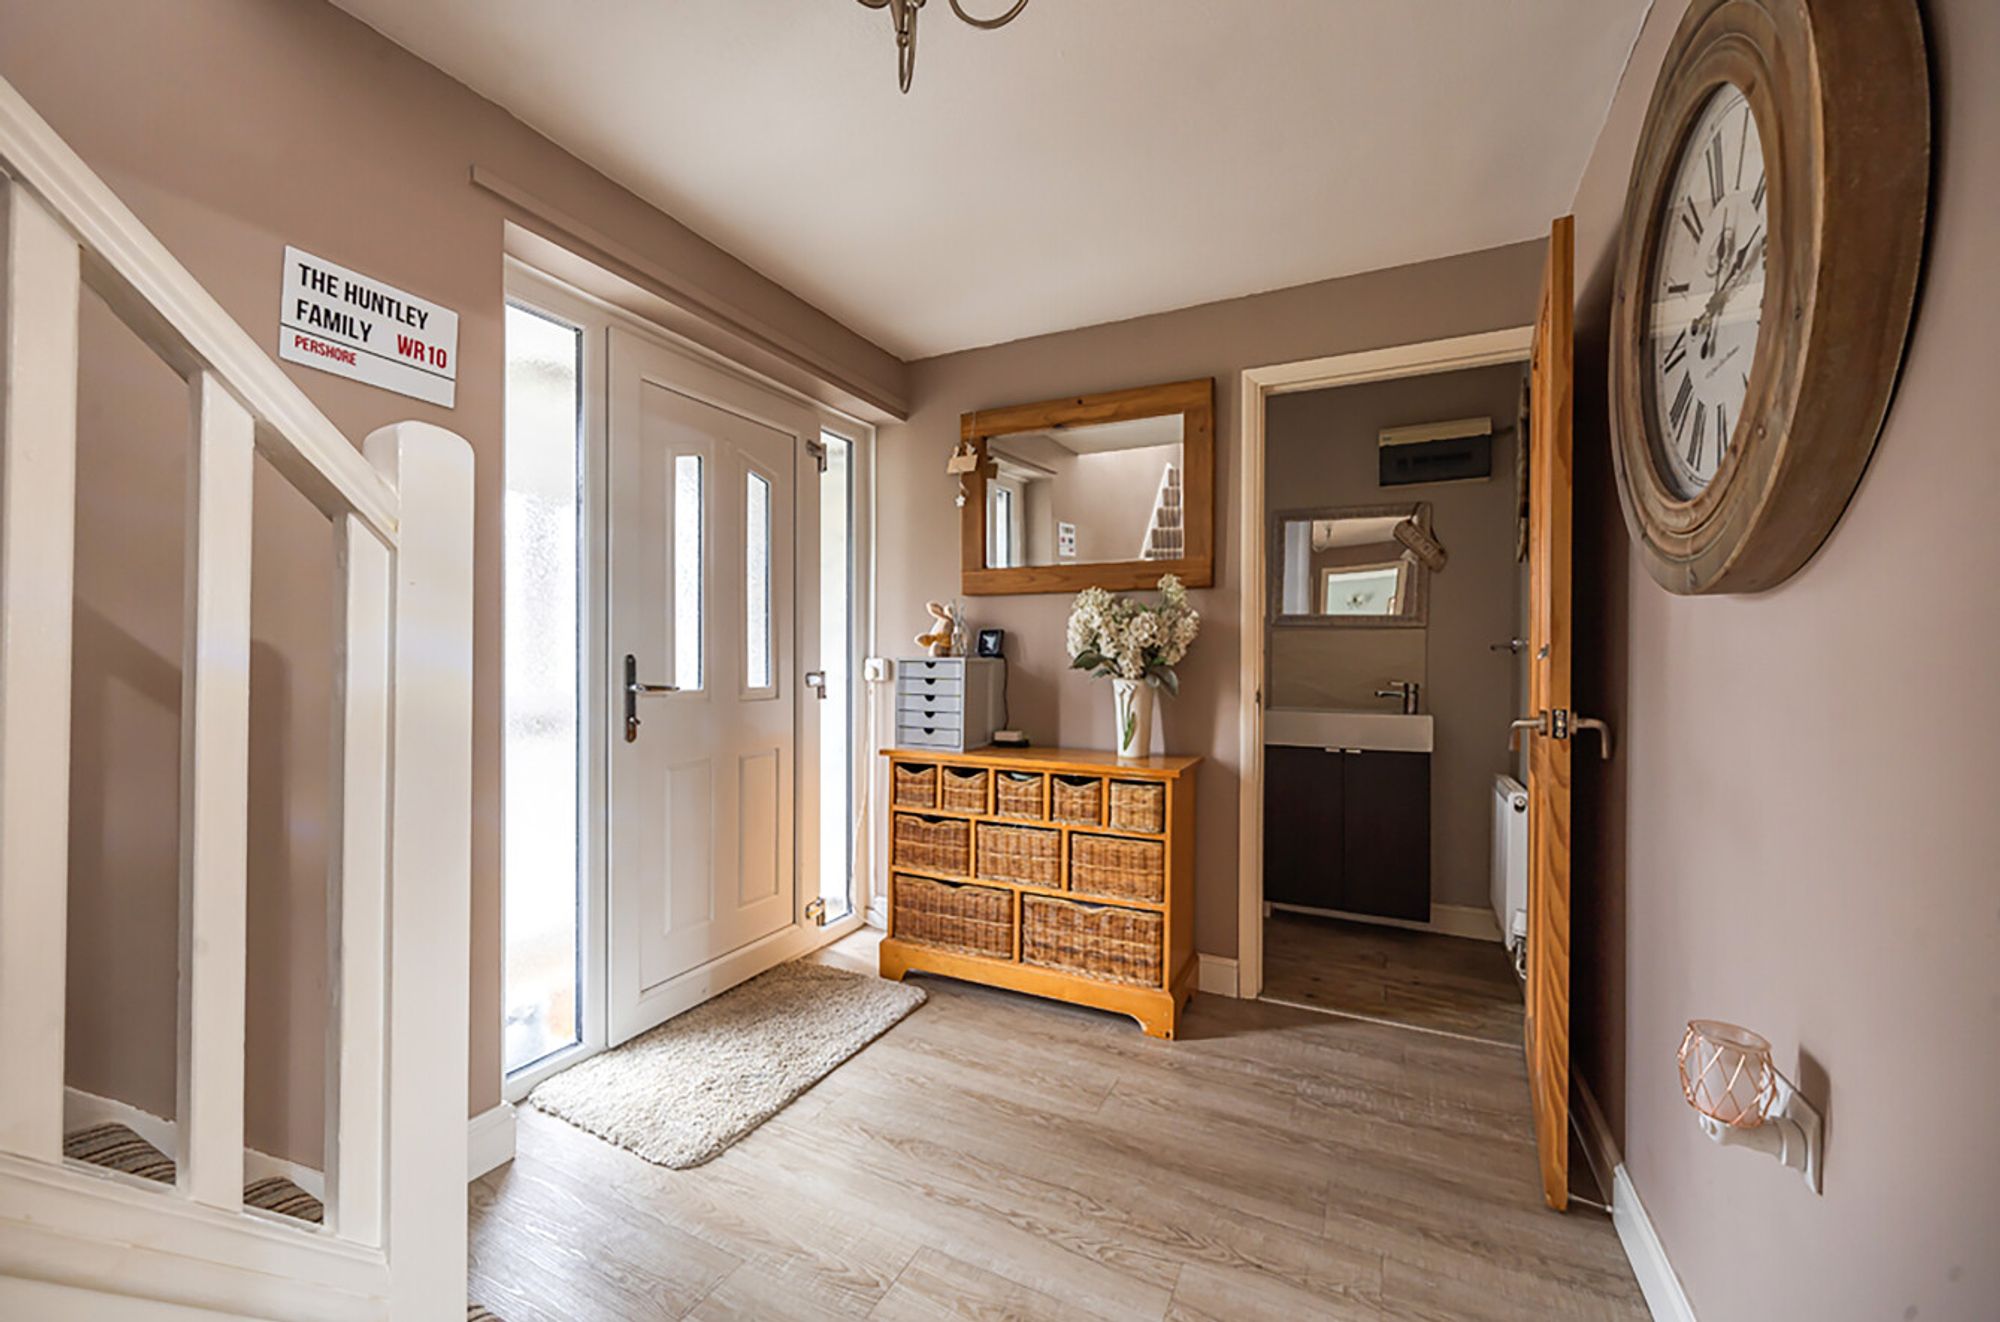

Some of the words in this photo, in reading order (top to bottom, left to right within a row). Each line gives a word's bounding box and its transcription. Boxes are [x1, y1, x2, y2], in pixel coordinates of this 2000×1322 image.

[298, 263, 339, 298] THE
[344, 281, 429, 330] HUNTLEY
[297, 299, 373, 343] FAMILY
[294, 334, 357, 366] PERSHORE
[397, 333, 447, 369] WR10
